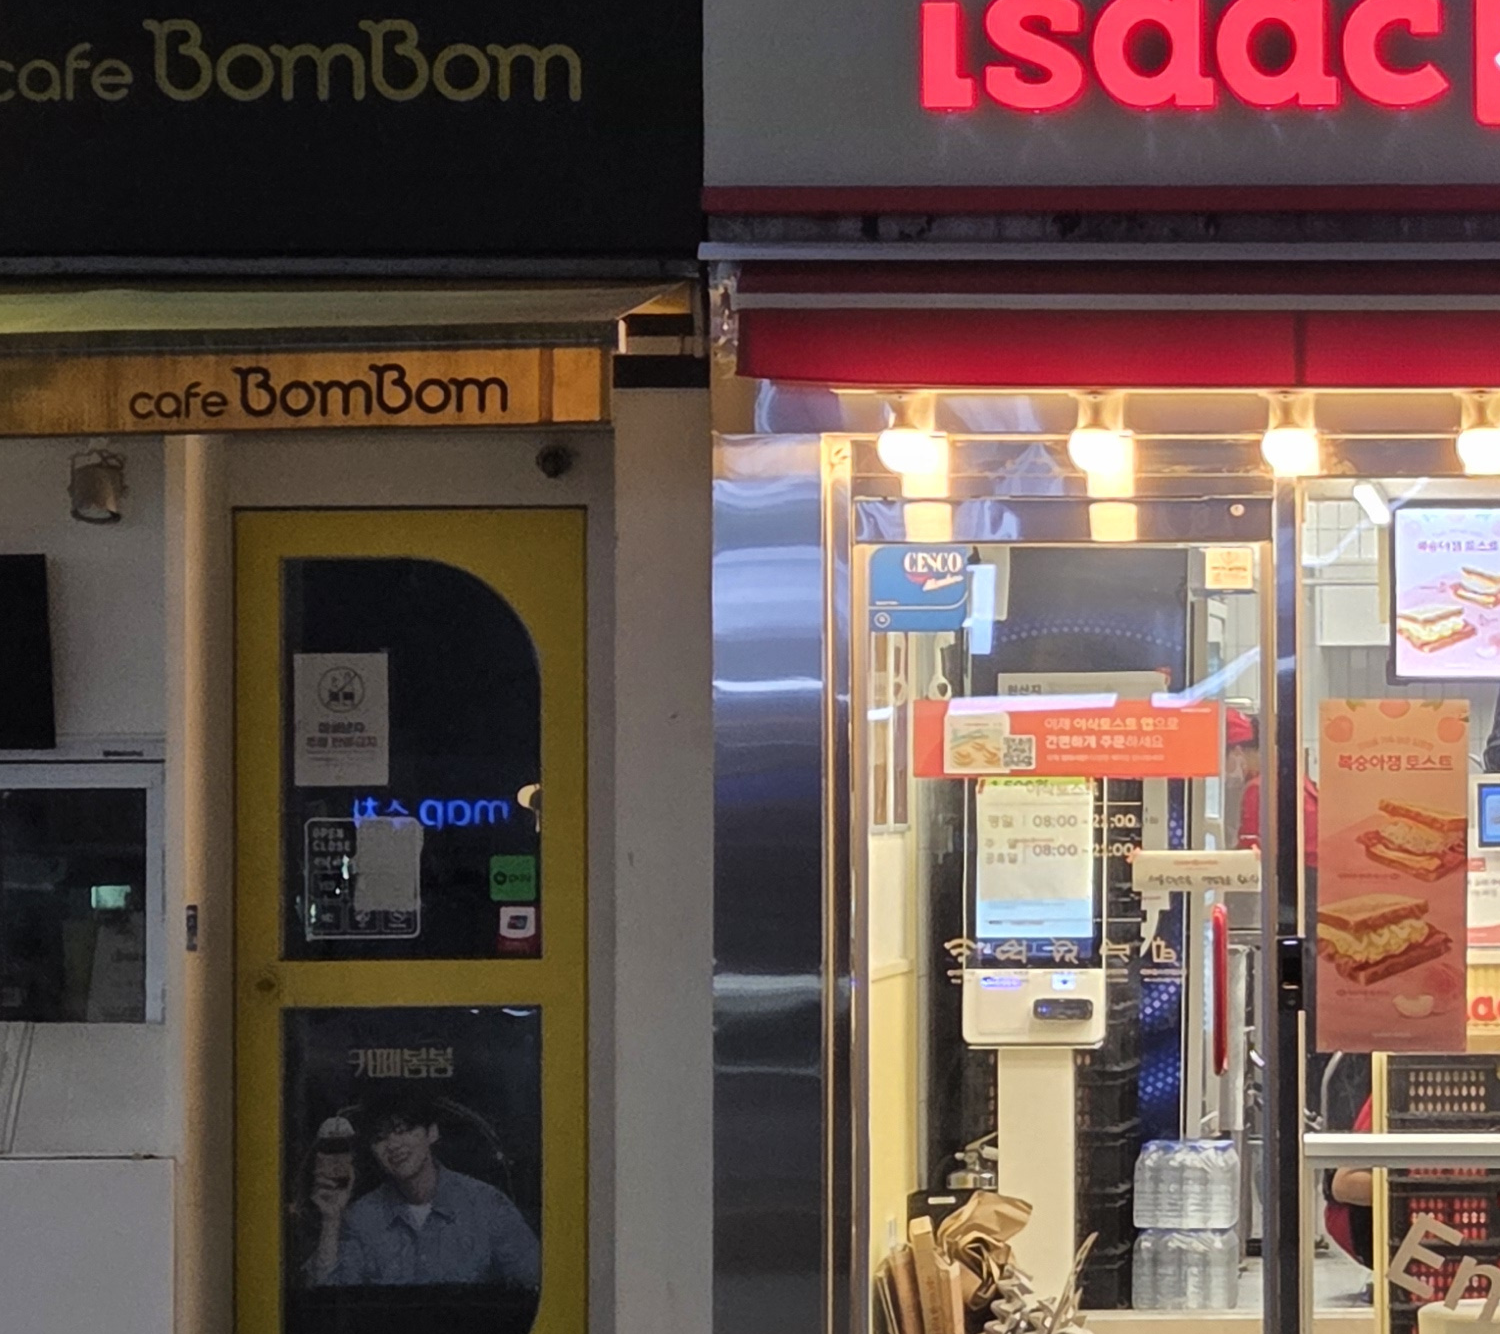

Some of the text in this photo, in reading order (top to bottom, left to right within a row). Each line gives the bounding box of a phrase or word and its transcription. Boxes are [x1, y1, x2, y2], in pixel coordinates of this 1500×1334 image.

[143, 19, 582, 102] BomBom
[129, 364, 508, 420] cafe BomBom
[1406, 754, 1453, 771] 토스트
[1033, 814, 1078, 828] 08:00
